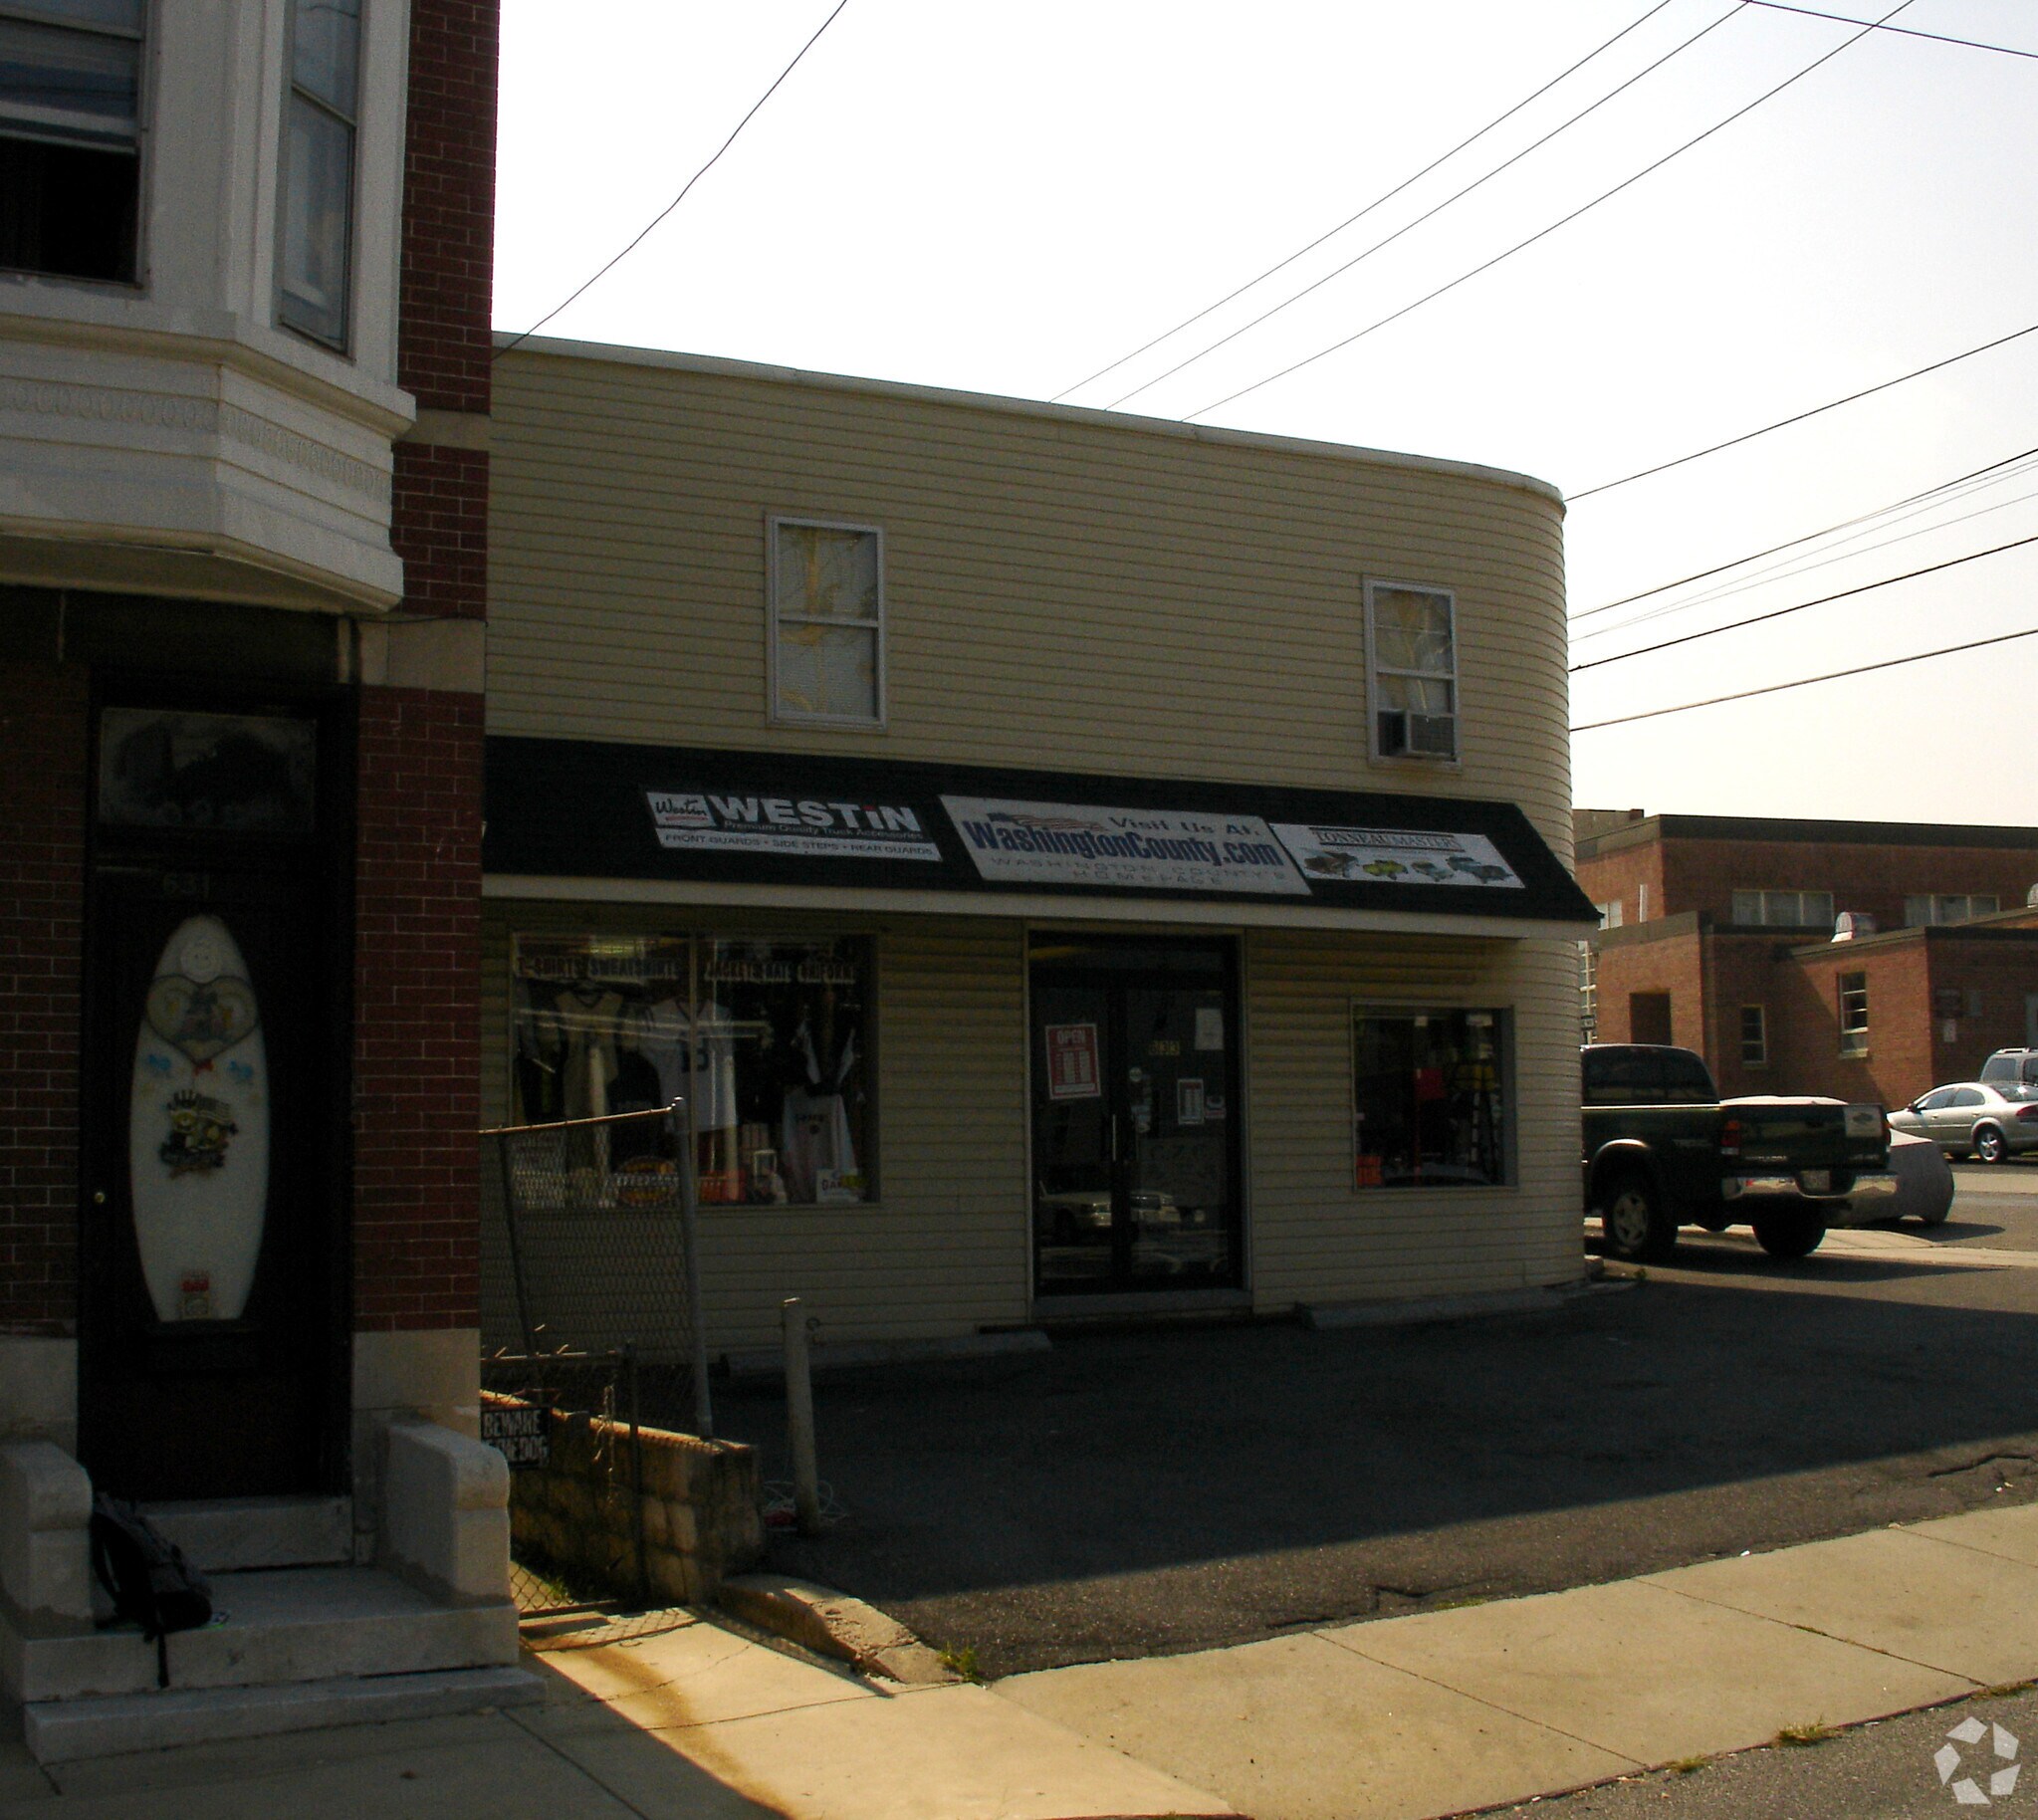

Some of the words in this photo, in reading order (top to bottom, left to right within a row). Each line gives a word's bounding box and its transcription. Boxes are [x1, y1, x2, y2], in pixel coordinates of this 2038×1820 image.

[655, 797, 708, 815] Westin
[1107, 816, 1170, 831] Visit
[1181, 821, 1215, 833] Us
[665, 833, 706, 844] FRONT
[709, 836, 761, 846] GUARDS
[773, 838, 799, 848] SIDE
[802, 840, 840, 850] STEPS
[851, 843, 883, 853] REAR
[884, 844, 934, 855] GUARDS
[962, 819, 1284, 866] WashingtonCounty.com
[1056, 1028, 1086, 1044] OPEN
[483, 1410, 541, 1437] BEWARE
